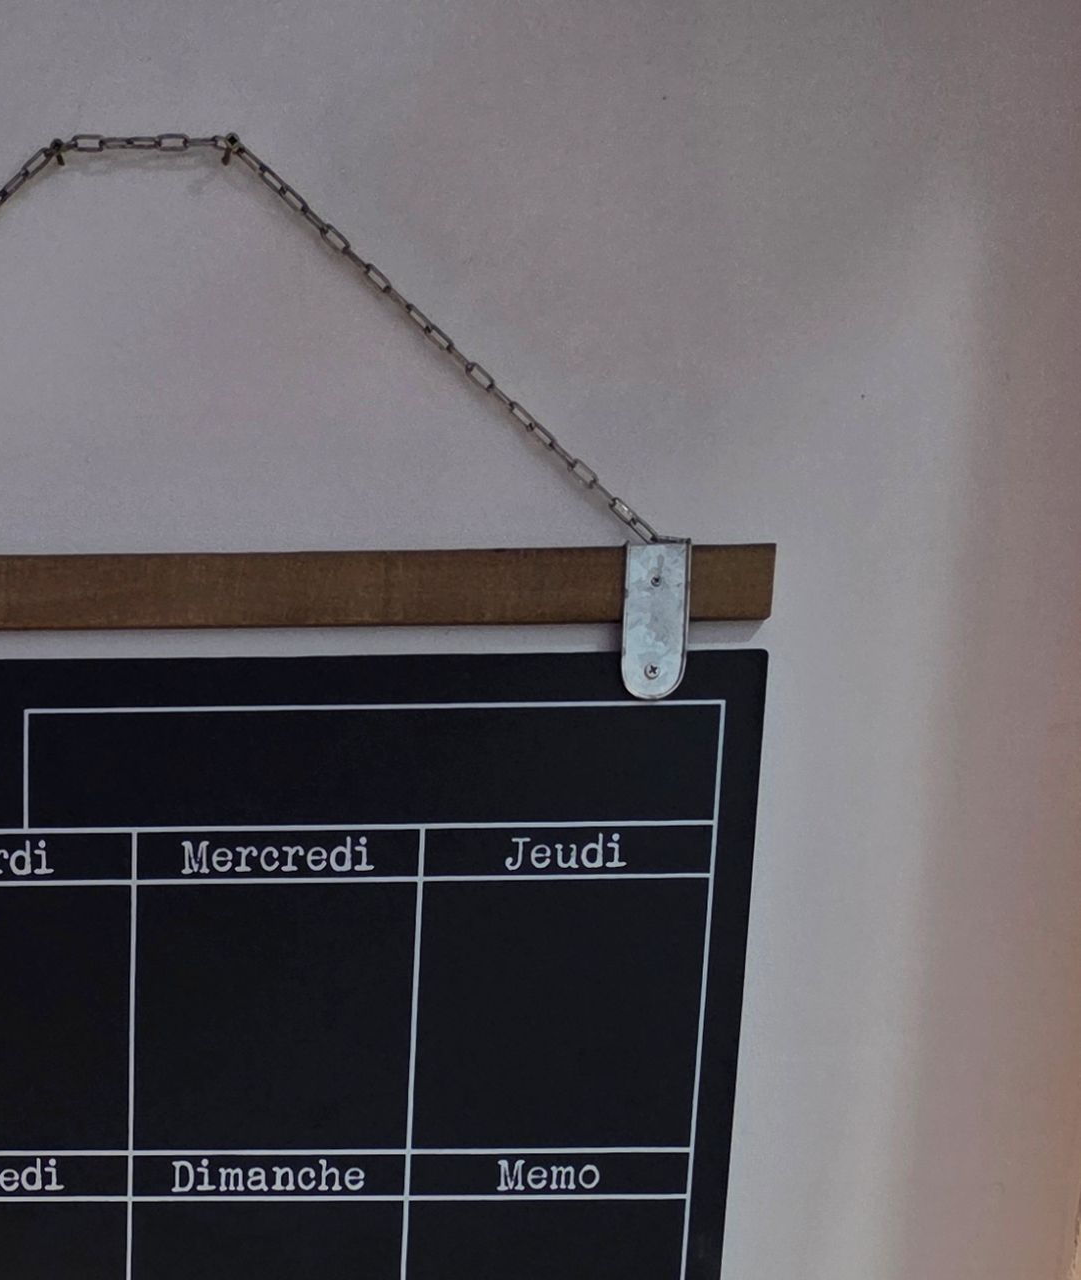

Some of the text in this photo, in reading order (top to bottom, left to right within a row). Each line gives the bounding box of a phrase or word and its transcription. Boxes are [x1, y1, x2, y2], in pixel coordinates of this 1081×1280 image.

[181, 836, 376, 875] Mercredi
[505, 832, 628, 871] Jeudi
[171, 1158, 366, 1193] Dimanche
[496, 1159, 601, 1191] Memo
